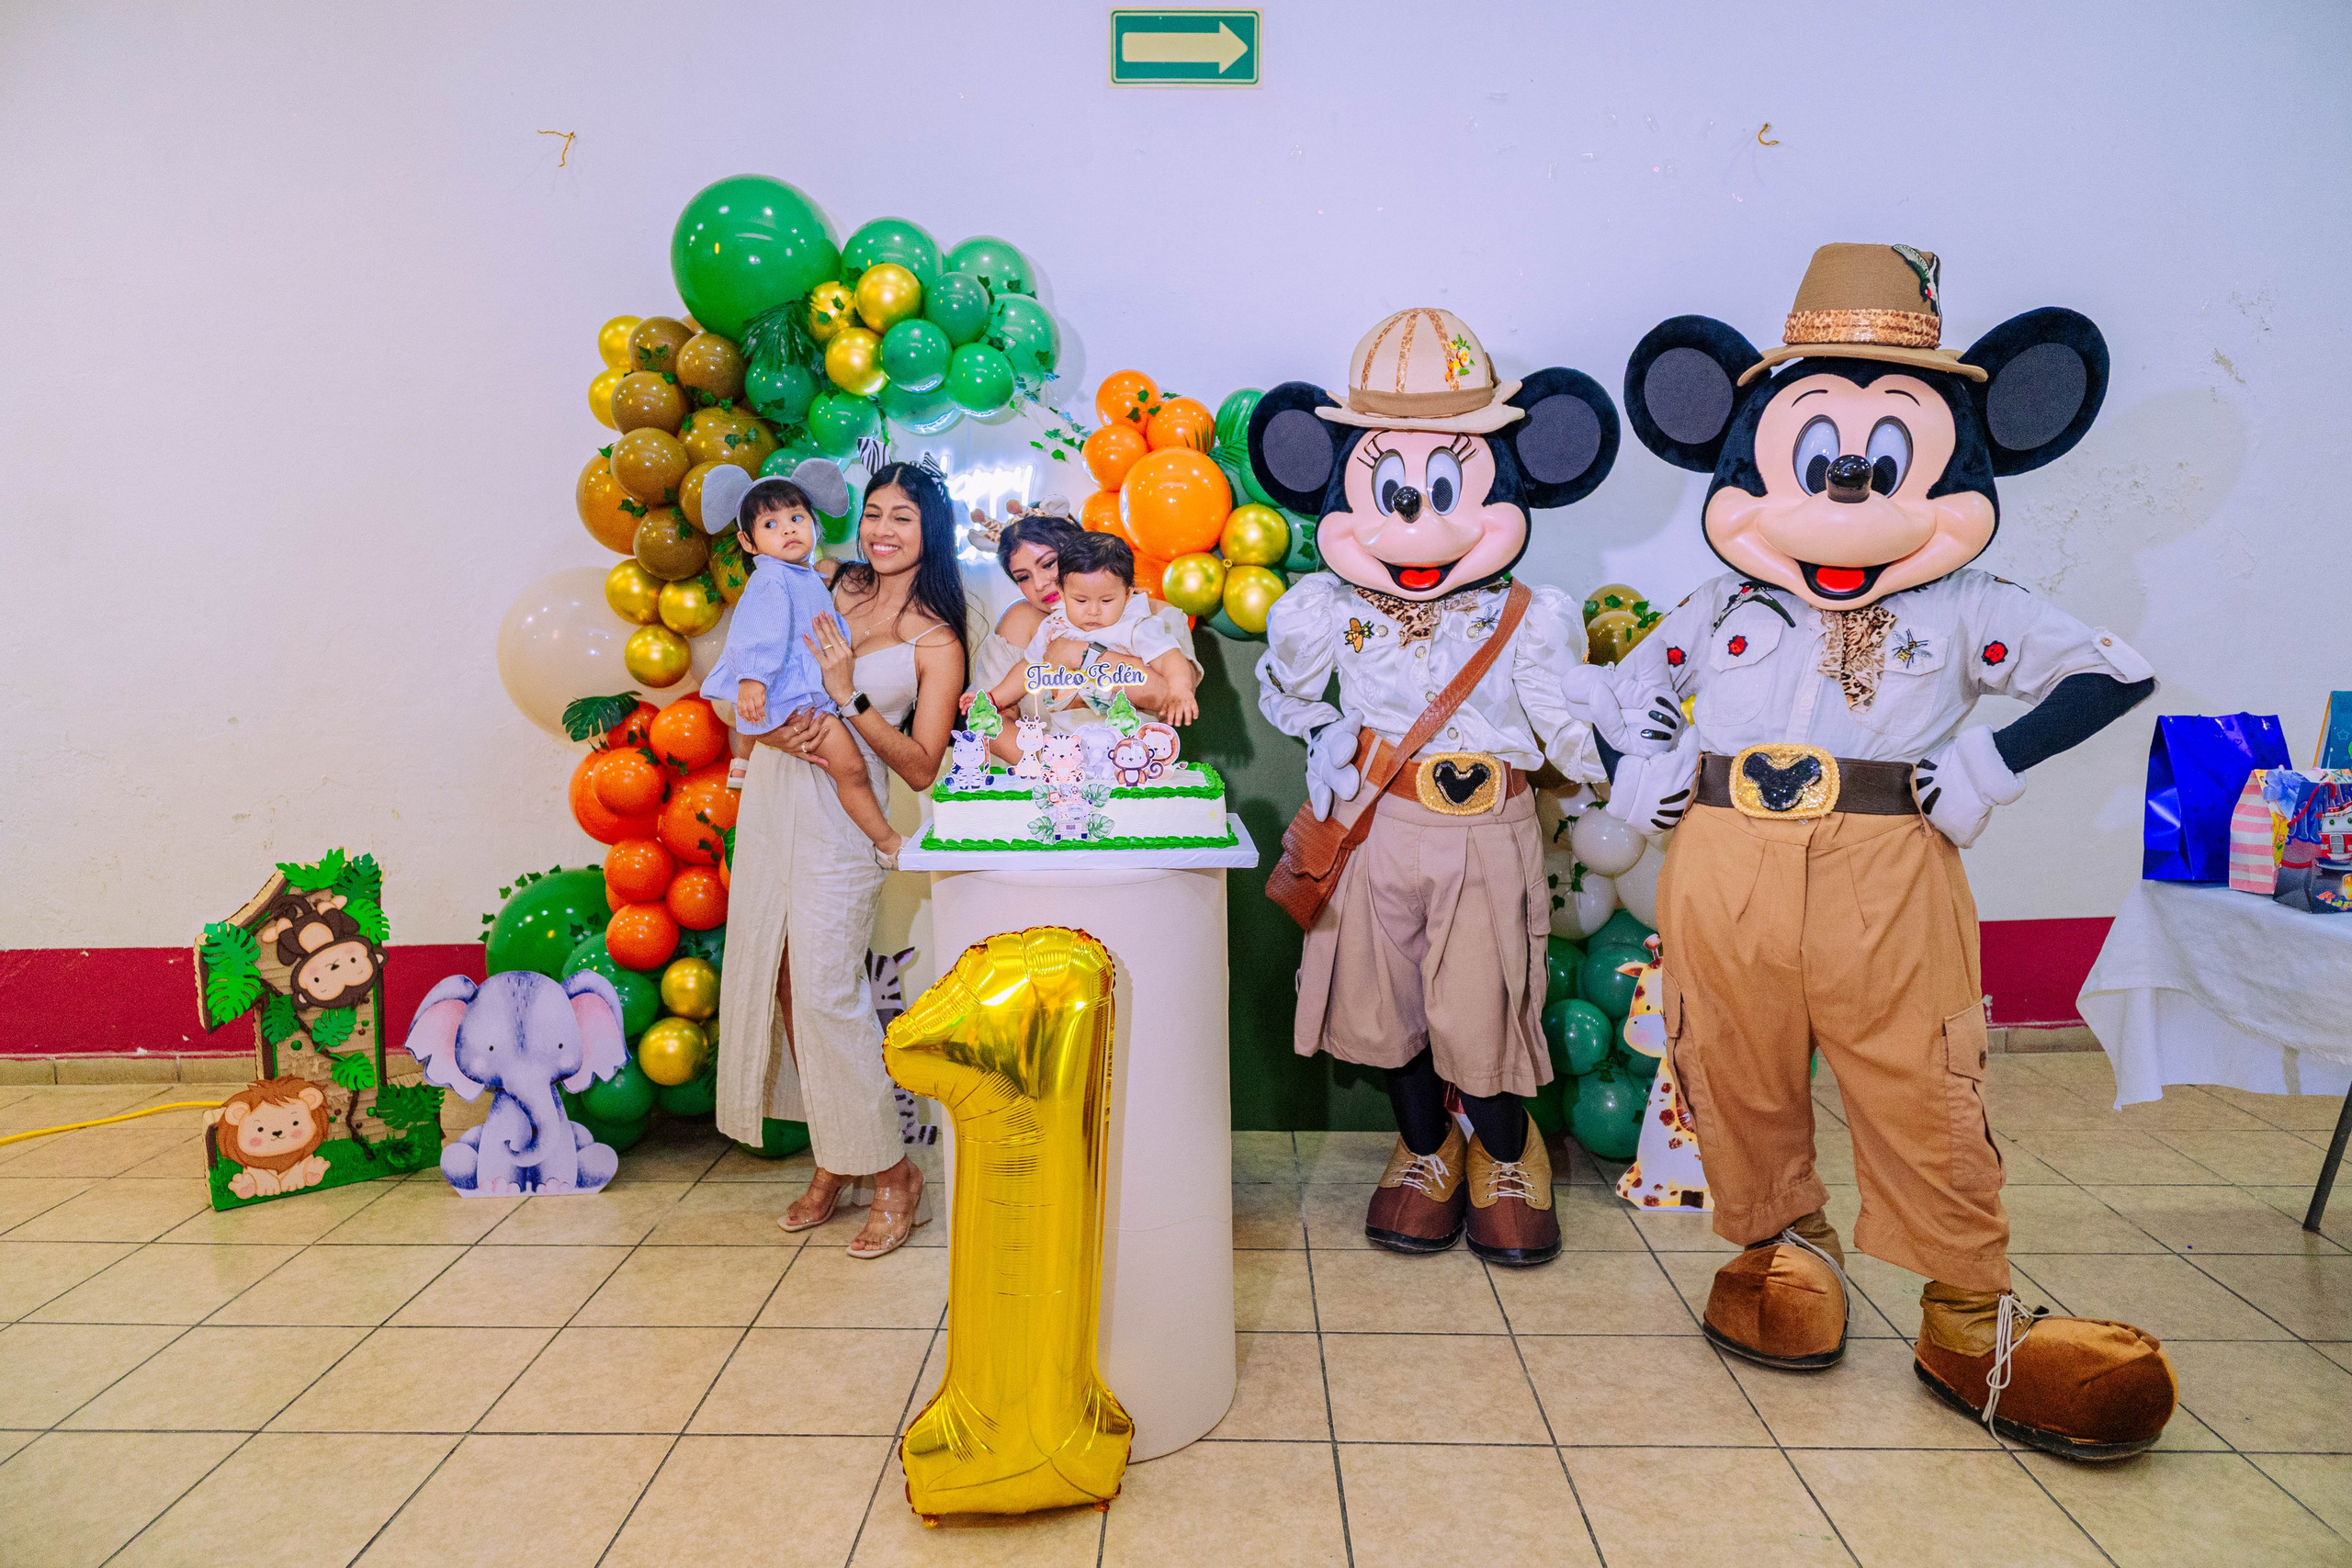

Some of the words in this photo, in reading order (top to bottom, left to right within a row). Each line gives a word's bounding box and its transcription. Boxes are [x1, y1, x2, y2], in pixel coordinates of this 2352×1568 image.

[1026, 663, 1087, 690] Tadeo
[1088, 662, 1146, 688] Edén
[882, 925, 1135, 1529] 1
